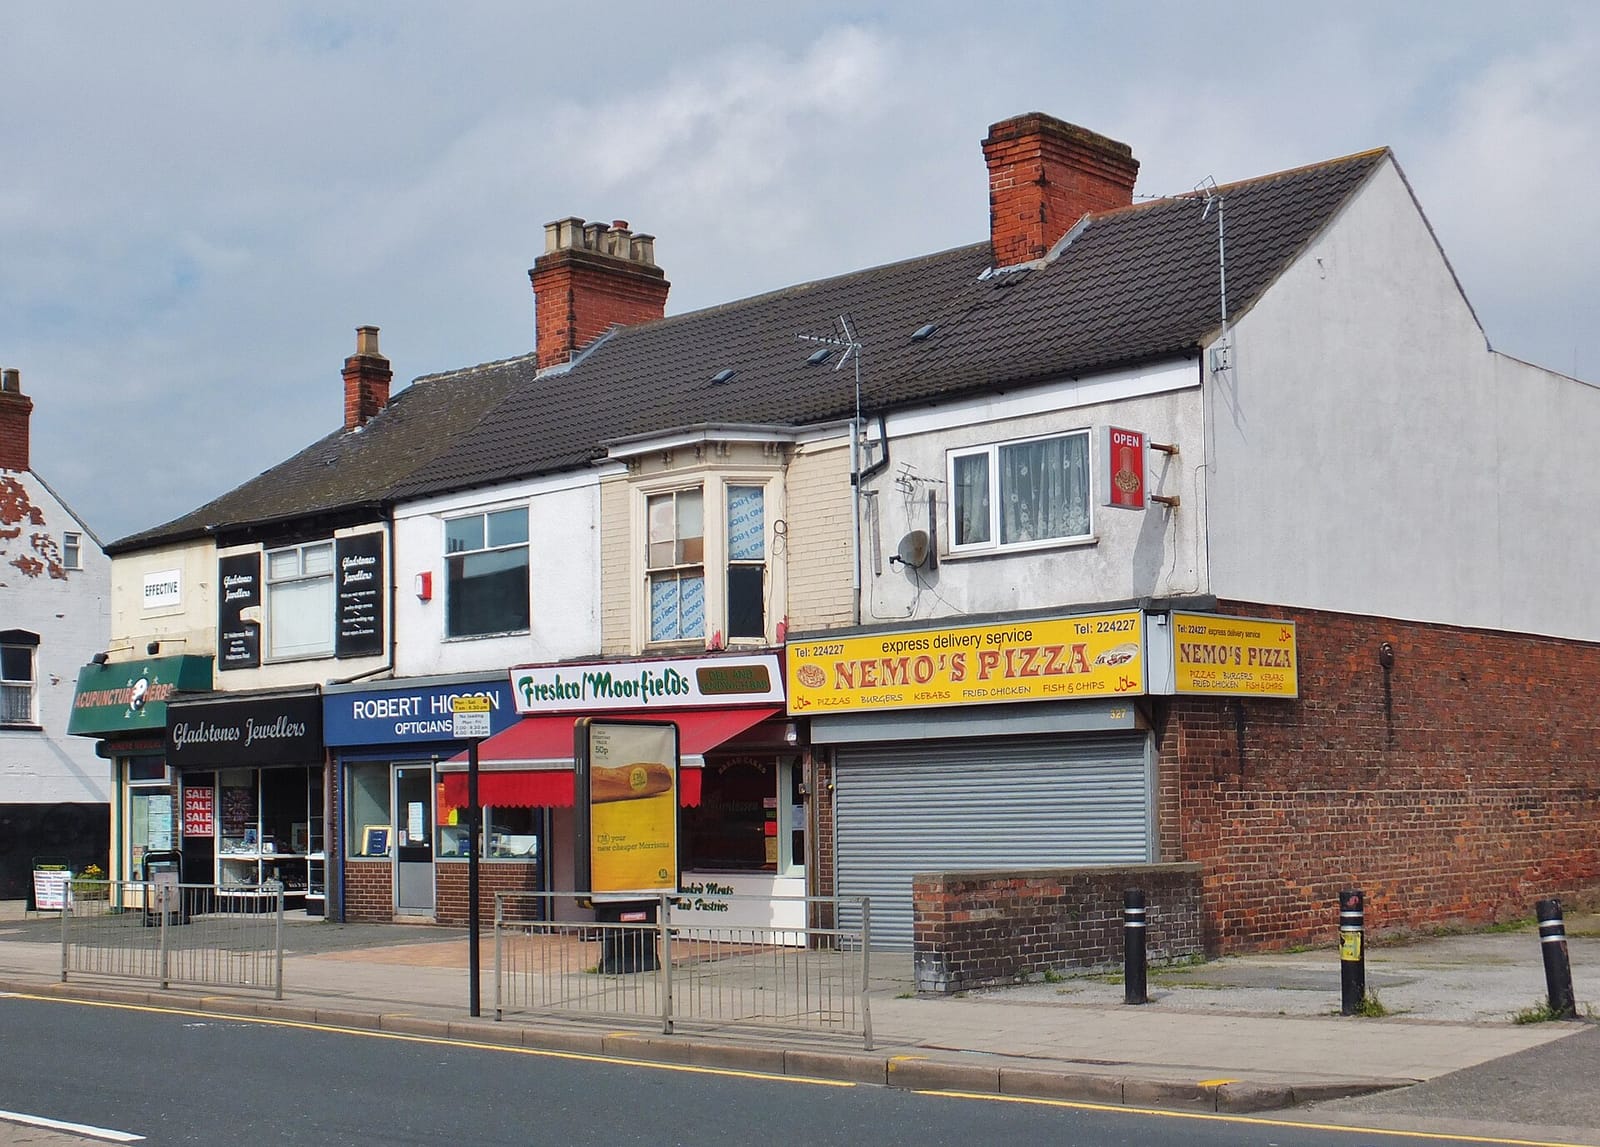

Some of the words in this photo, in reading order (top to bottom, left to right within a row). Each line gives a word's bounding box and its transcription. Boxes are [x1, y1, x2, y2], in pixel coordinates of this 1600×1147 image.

[1113, 432, 1139, 447] OPEN
[145, 581, 178, 597] EFFECTIVE
[1074, 623, 1093, 635] Tel:
[1096, 619, 1135, 633] 224227
[1177, 624, 1187, 634] Tel:
[1188, 625, 1207, 635] 224227
[1208, 628, 1227, 637] express
[1227, 629, 1244, 639] delivery
[1245, 631, 1261, 639] service
[882, 639, 929, 655] express
[933, 633, 981, 649] delivery
[986, 628, 1033, 645] service
[795, 647, 811, 658] Tel:
[813, 644, 844, 657] 224227
[1180, 642, 1241, 666] NEMO'S
[1248, 647, 1291, 668] PIZZA
[834, 652, 967, 690] NEMO'S
[978, 643, 1092, 681] PIZZA
[1189, 670, 1216, 679] PIZZAS
[1223, 671, 1254, 681] BURGERS
[1260, 673, 1284, 682] KEBABS
[1192, 679, 1210, 688] FRIED
[1212, 680, 1239, 689] CHICKEN
[1245, 681, 1260, 690] FISH
[1265, 682, 1283, 691] CHIPS
[817, 697, 850, 706] PIZZAS
[861, 694, 903, 704] BURGERS
[914, 691, 951, 700] KEBABS
[962, 688, 988, 698] FRIED
[990, 686, 1031, 696] CHICKEN
[1042, 683, 1065, 693] FISH
[1075, 681, 1105, 691] CHIPS
[353, 696, 422, 720] ROBERT
[1110, 709, 1126, 719] 327
[173, 721, 240, 751] Gladstones
[244, 715, 306, 747] Jewellers
[395, 719, 453, 735] OPTICIANS
[595, 746, 608, 755] 50p
[186, 790, 213, 799] SALE
[186, 801, 213, 811] SALE
[186, 812, 213, 822] SALE
[186, 824, 213, 834] SALE
[705, 882, 734, 895] Meats
[695, 898, 729, 912] Pastries
